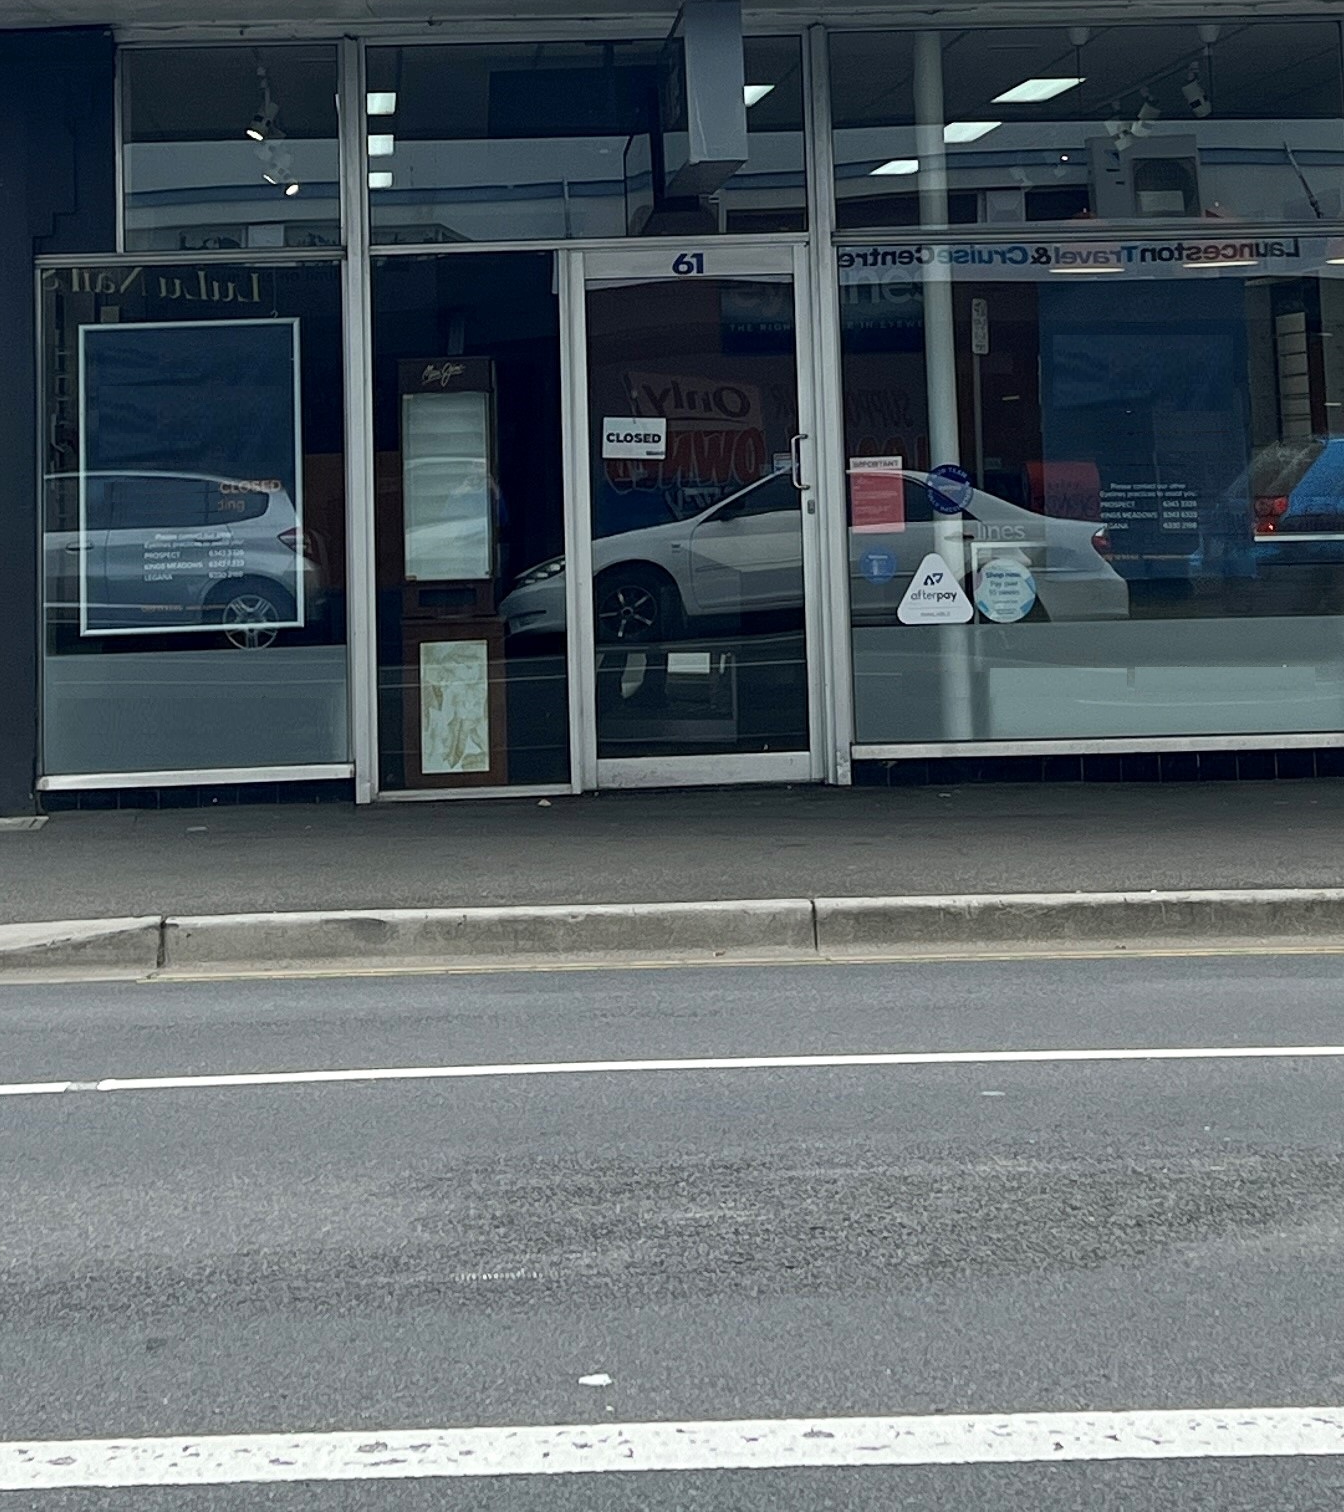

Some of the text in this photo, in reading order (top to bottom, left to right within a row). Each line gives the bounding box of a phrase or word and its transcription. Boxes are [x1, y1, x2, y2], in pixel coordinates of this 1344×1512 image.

[672, 252, 705, 275] 61
[606, 432, 662, 445] CLOSED
[219, 479, 282, 494] CLOSED
[910, 589, 958, 603] afterpay
